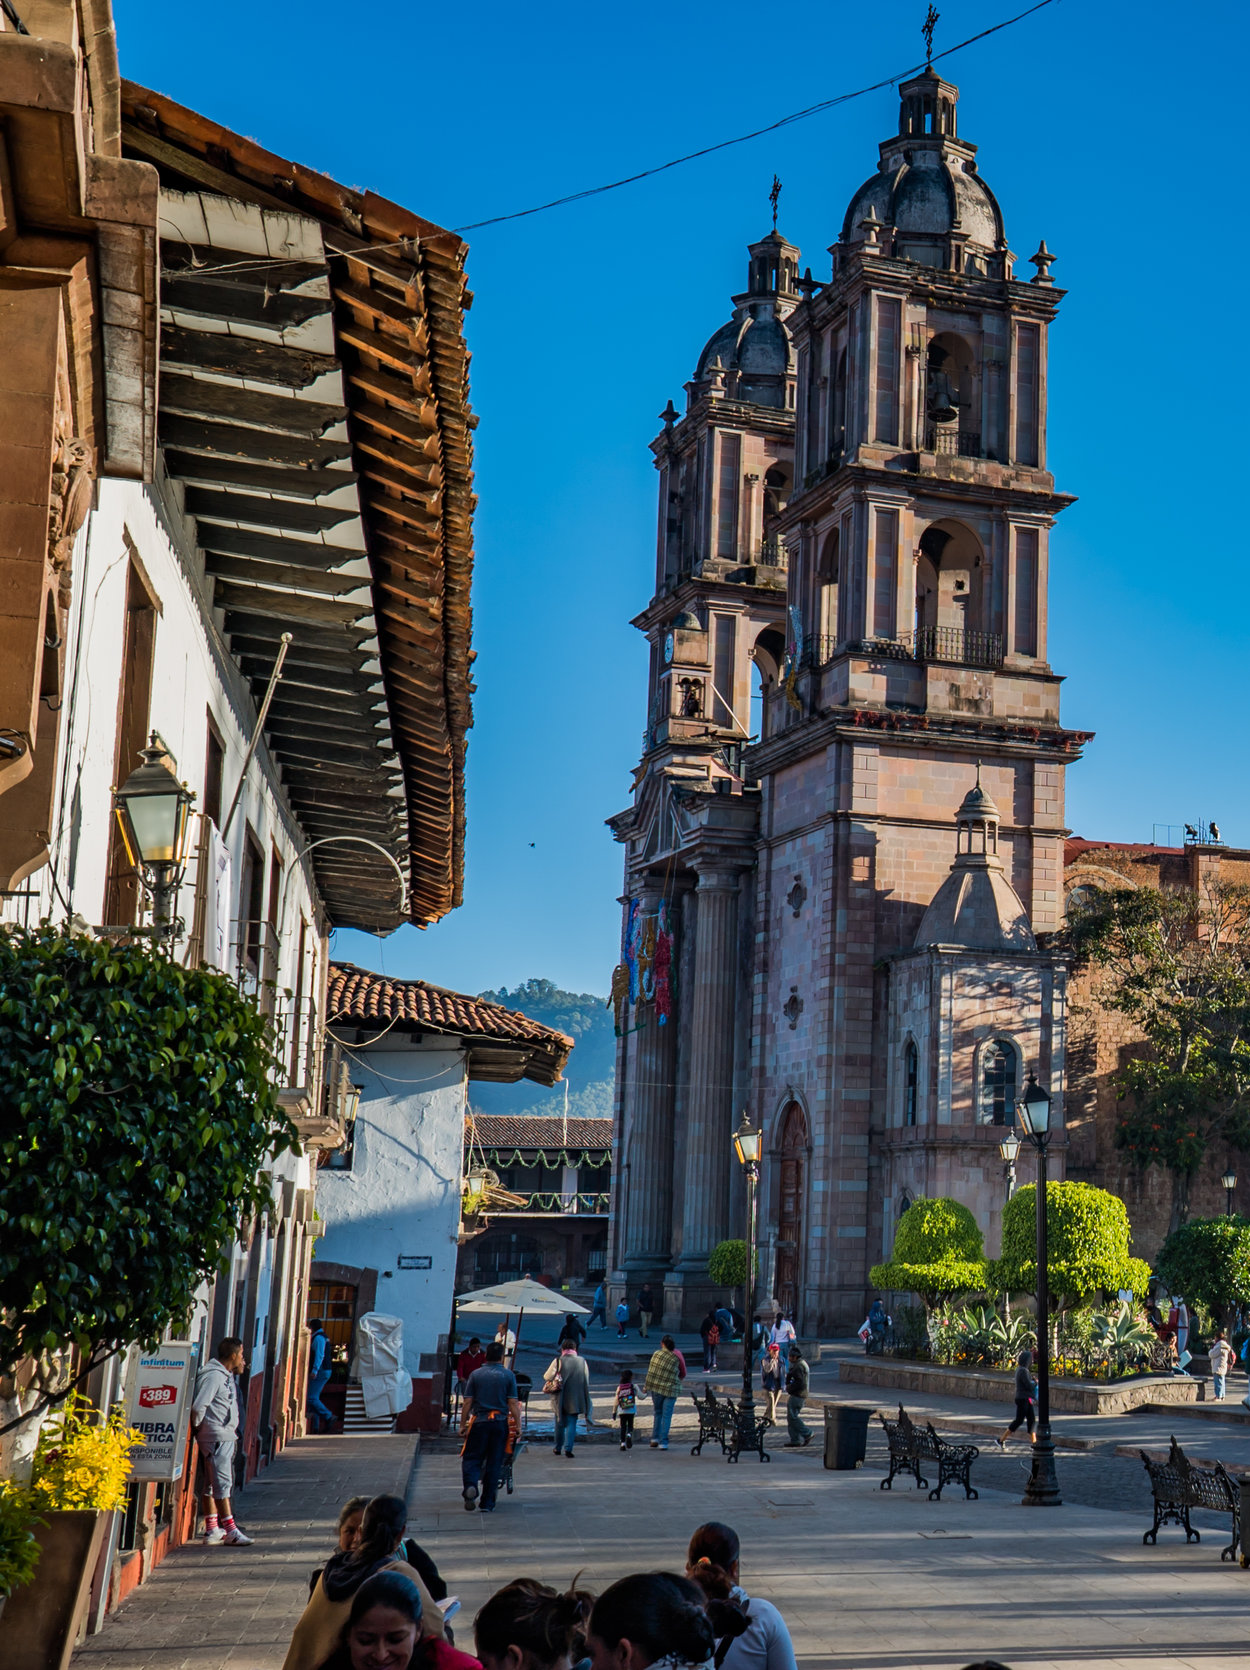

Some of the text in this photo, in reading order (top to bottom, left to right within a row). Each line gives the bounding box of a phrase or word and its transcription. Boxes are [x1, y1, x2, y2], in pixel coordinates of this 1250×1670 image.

[142, 1390, 170, 1401] $389
[132, 1422, 175, 1433] FIBRA
[145, 1433, 174, 1443] TICA
